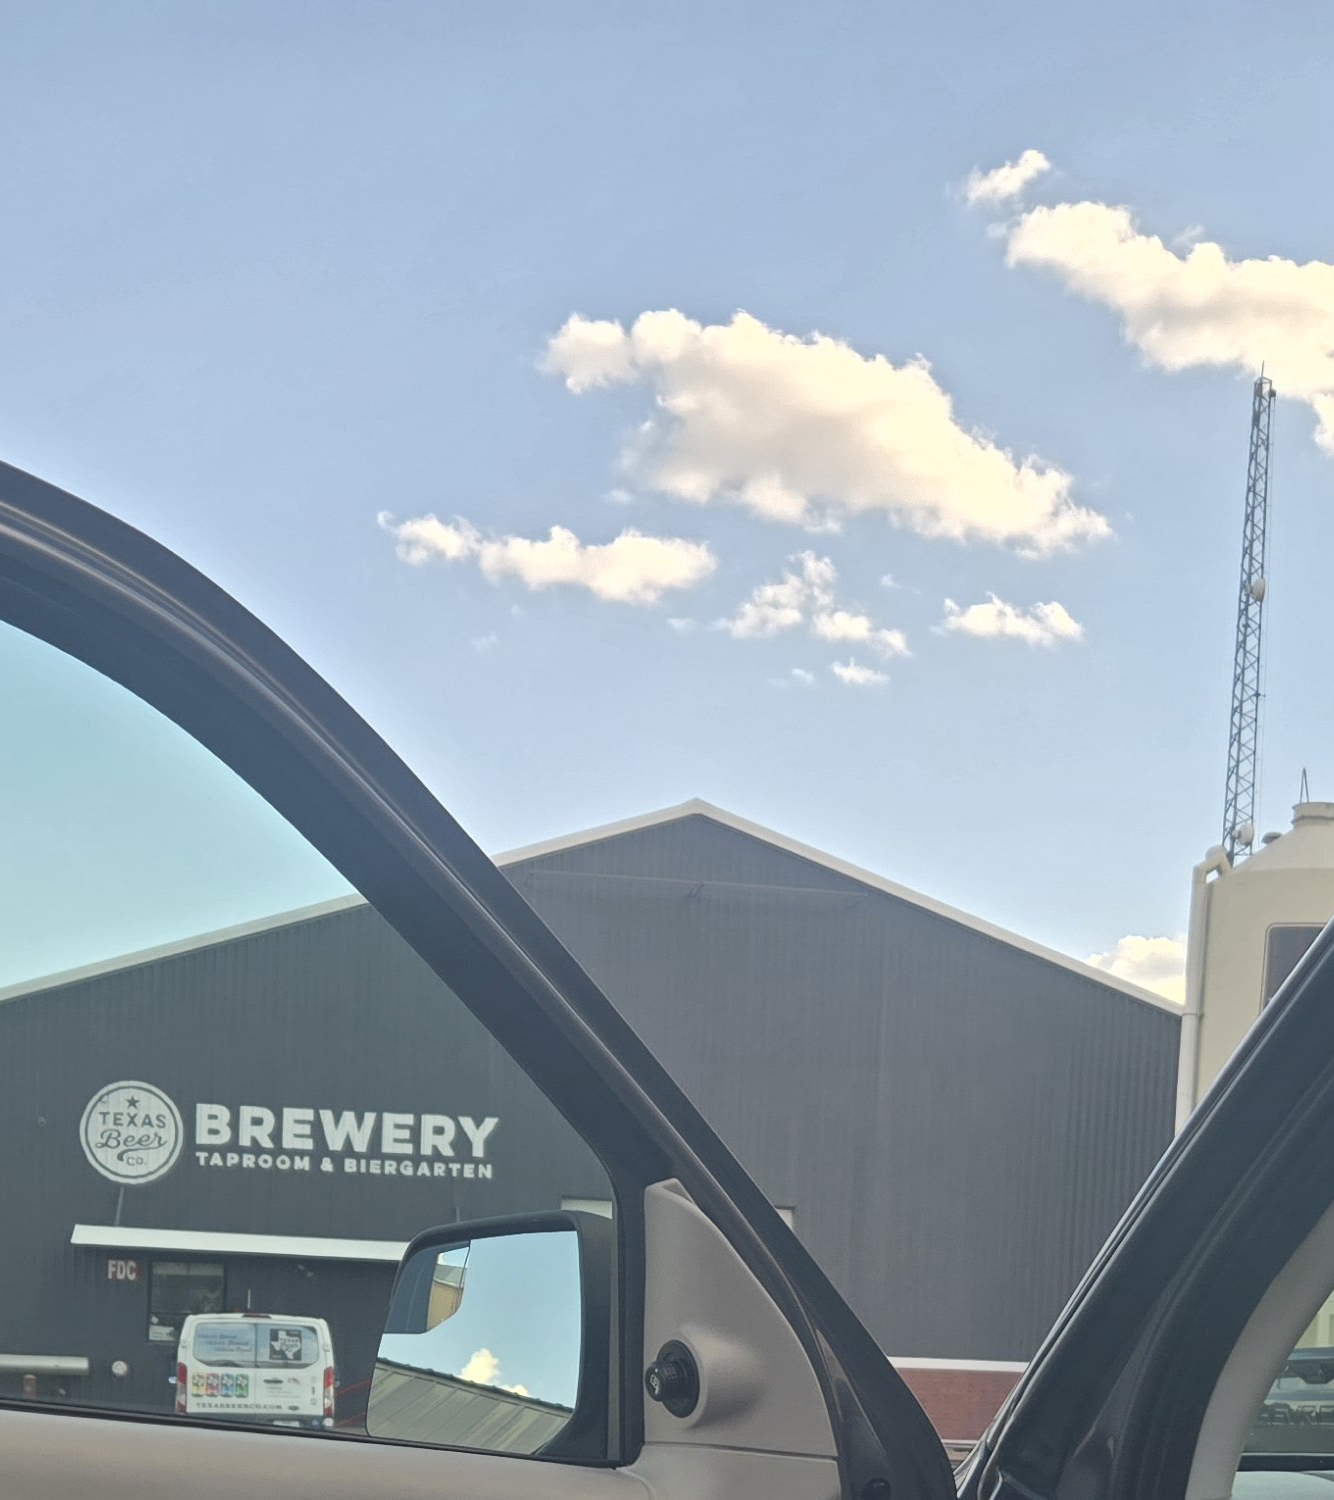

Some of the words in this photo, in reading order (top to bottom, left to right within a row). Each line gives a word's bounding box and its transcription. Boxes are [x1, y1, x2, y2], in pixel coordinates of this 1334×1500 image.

[98, 1111, 167, 1129] TEXAS
[195, 1102, 500, 1158] BREWERY
[94, 1129, 167, 1156] Beer
[195, 1151, 310, 1171] TAPROOM
[320, 1157, 334, 1172] &
[343, 1158, 493, 1179] BIERGARTEN
[107, 1260, 138, 1281] FDC
